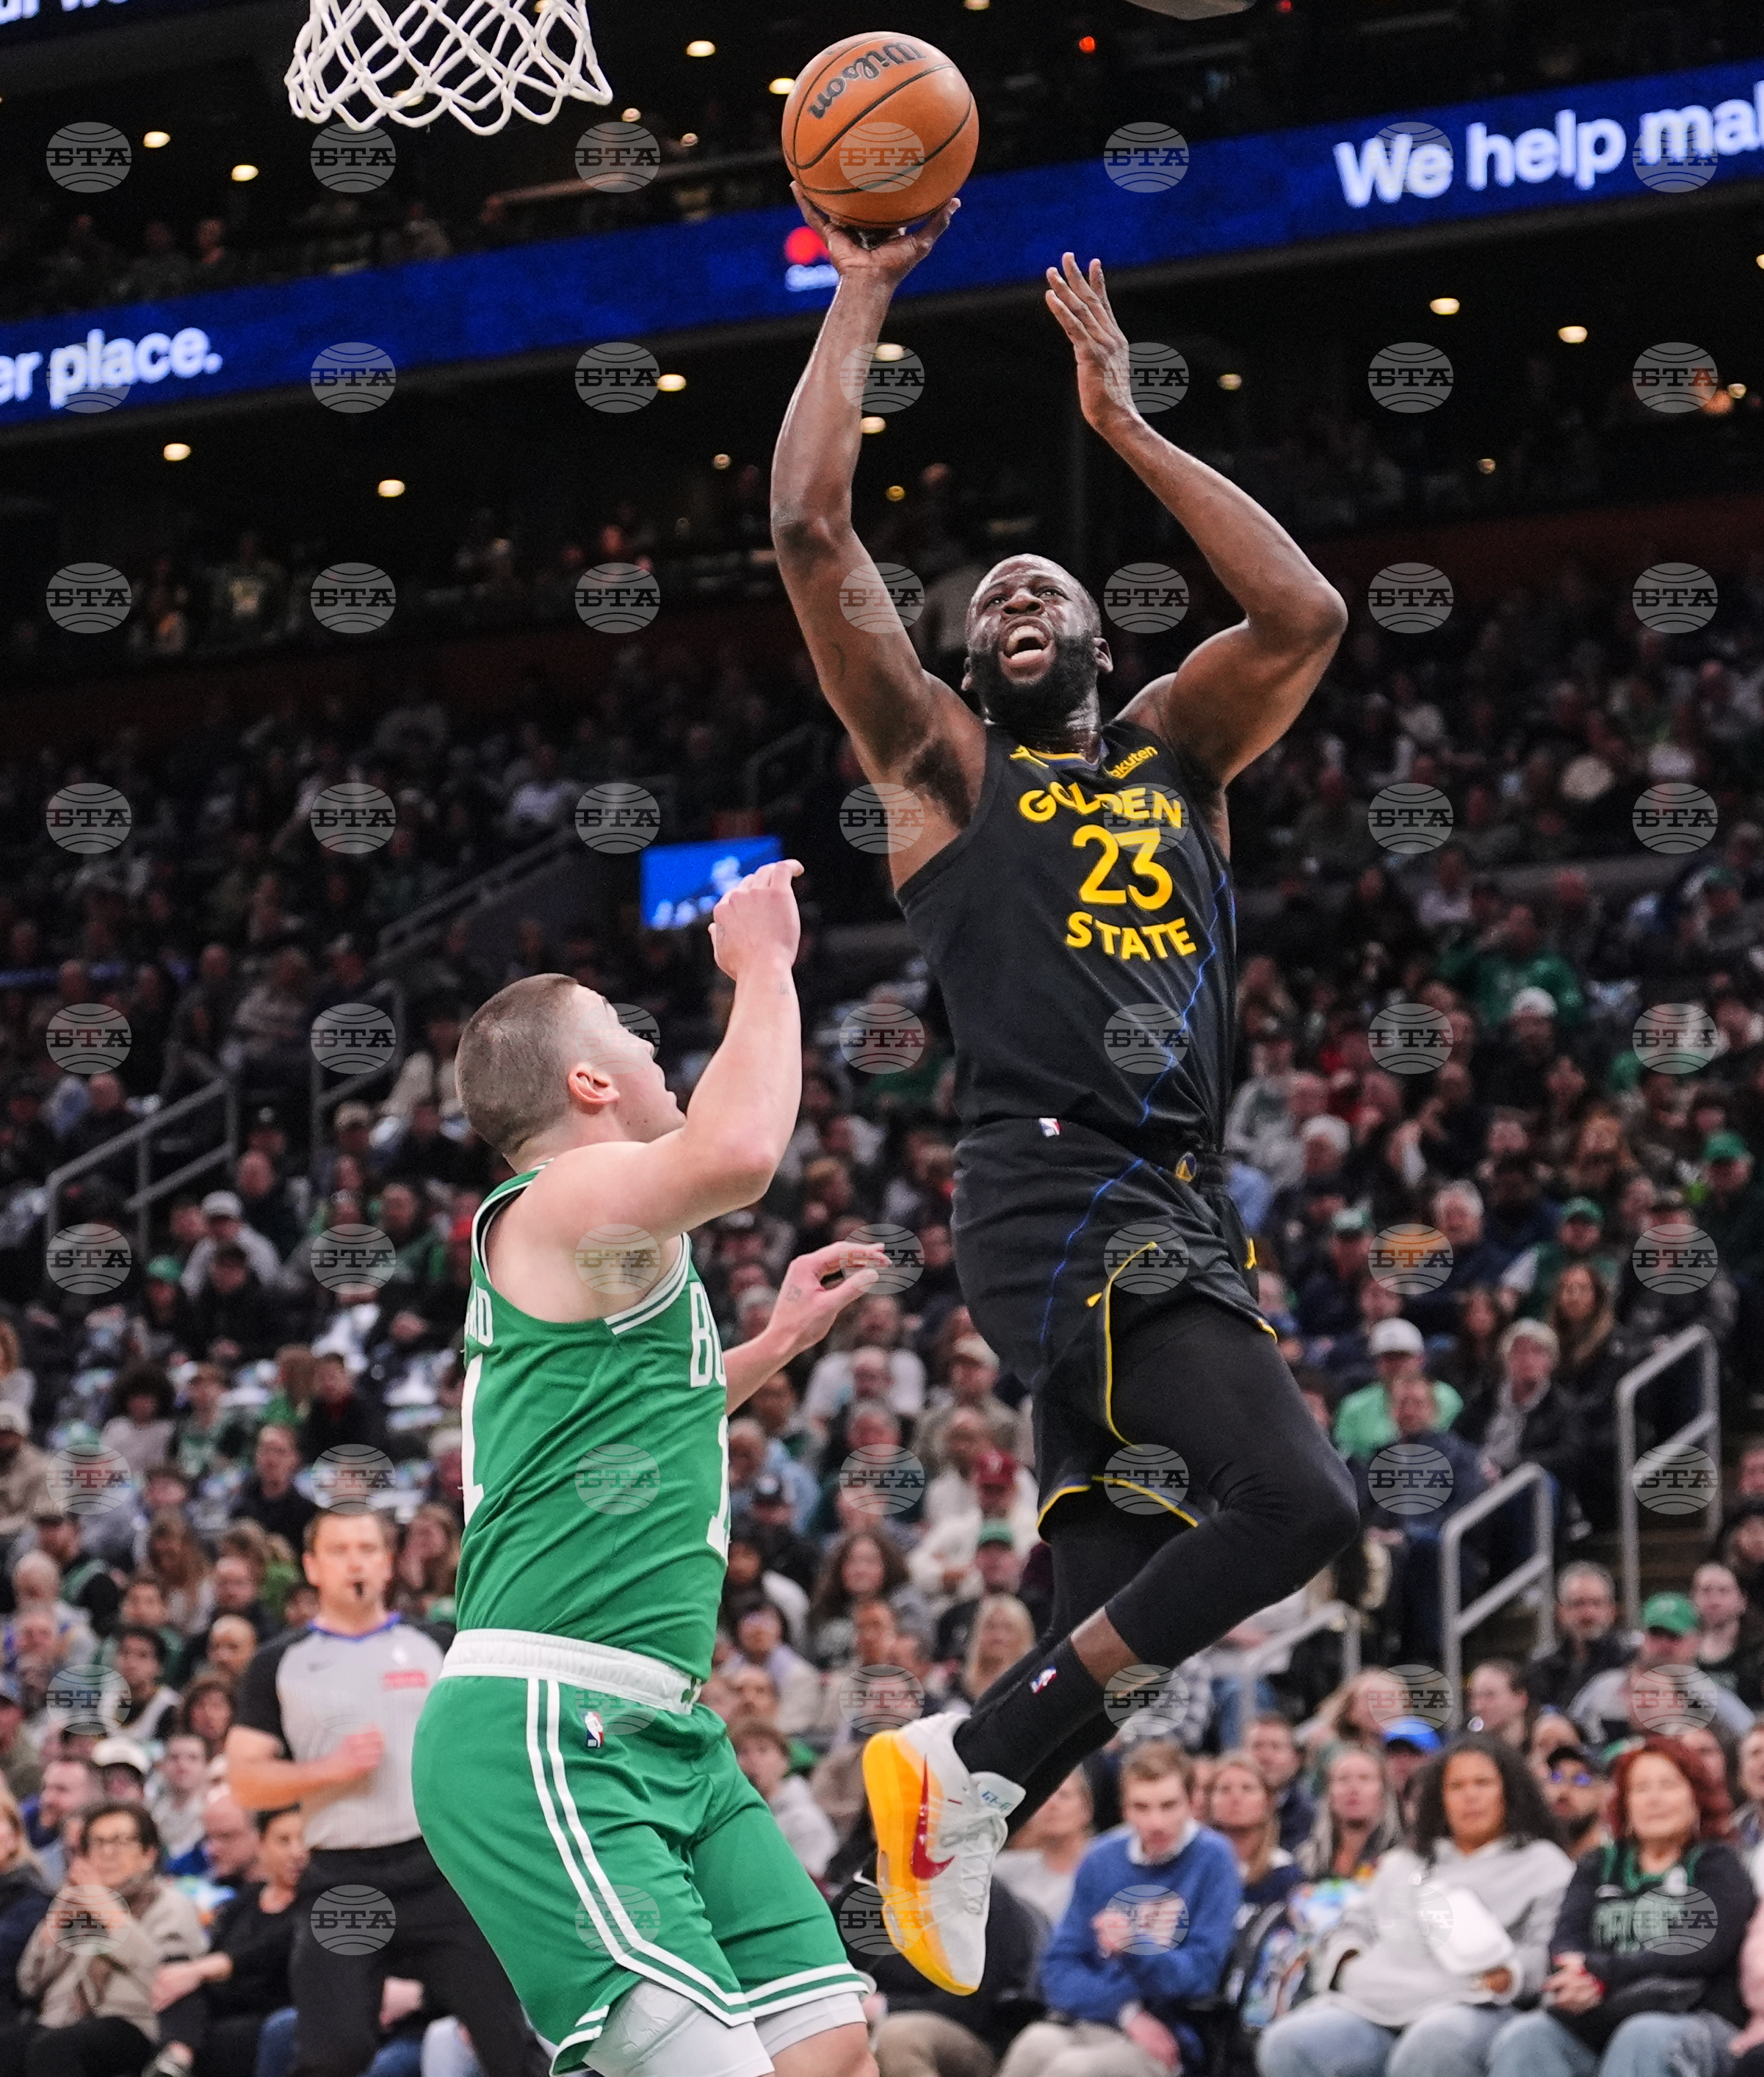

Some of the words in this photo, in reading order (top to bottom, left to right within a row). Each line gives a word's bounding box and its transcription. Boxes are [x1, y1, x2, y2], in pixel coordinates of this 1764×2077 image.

[809, 42, 926, 120] Wilson
[1333, 133, 1453, 208] We
[1466, 109, 1626, 190] help
[49, 327, 223, 410] place.
[1108, 745, 1158, 779] akuten
[1019, 781, 1182, 828] GOLDEN
[1072, 824, 1173, 910] 23
[1066, 911, 1196, 961] STATE
